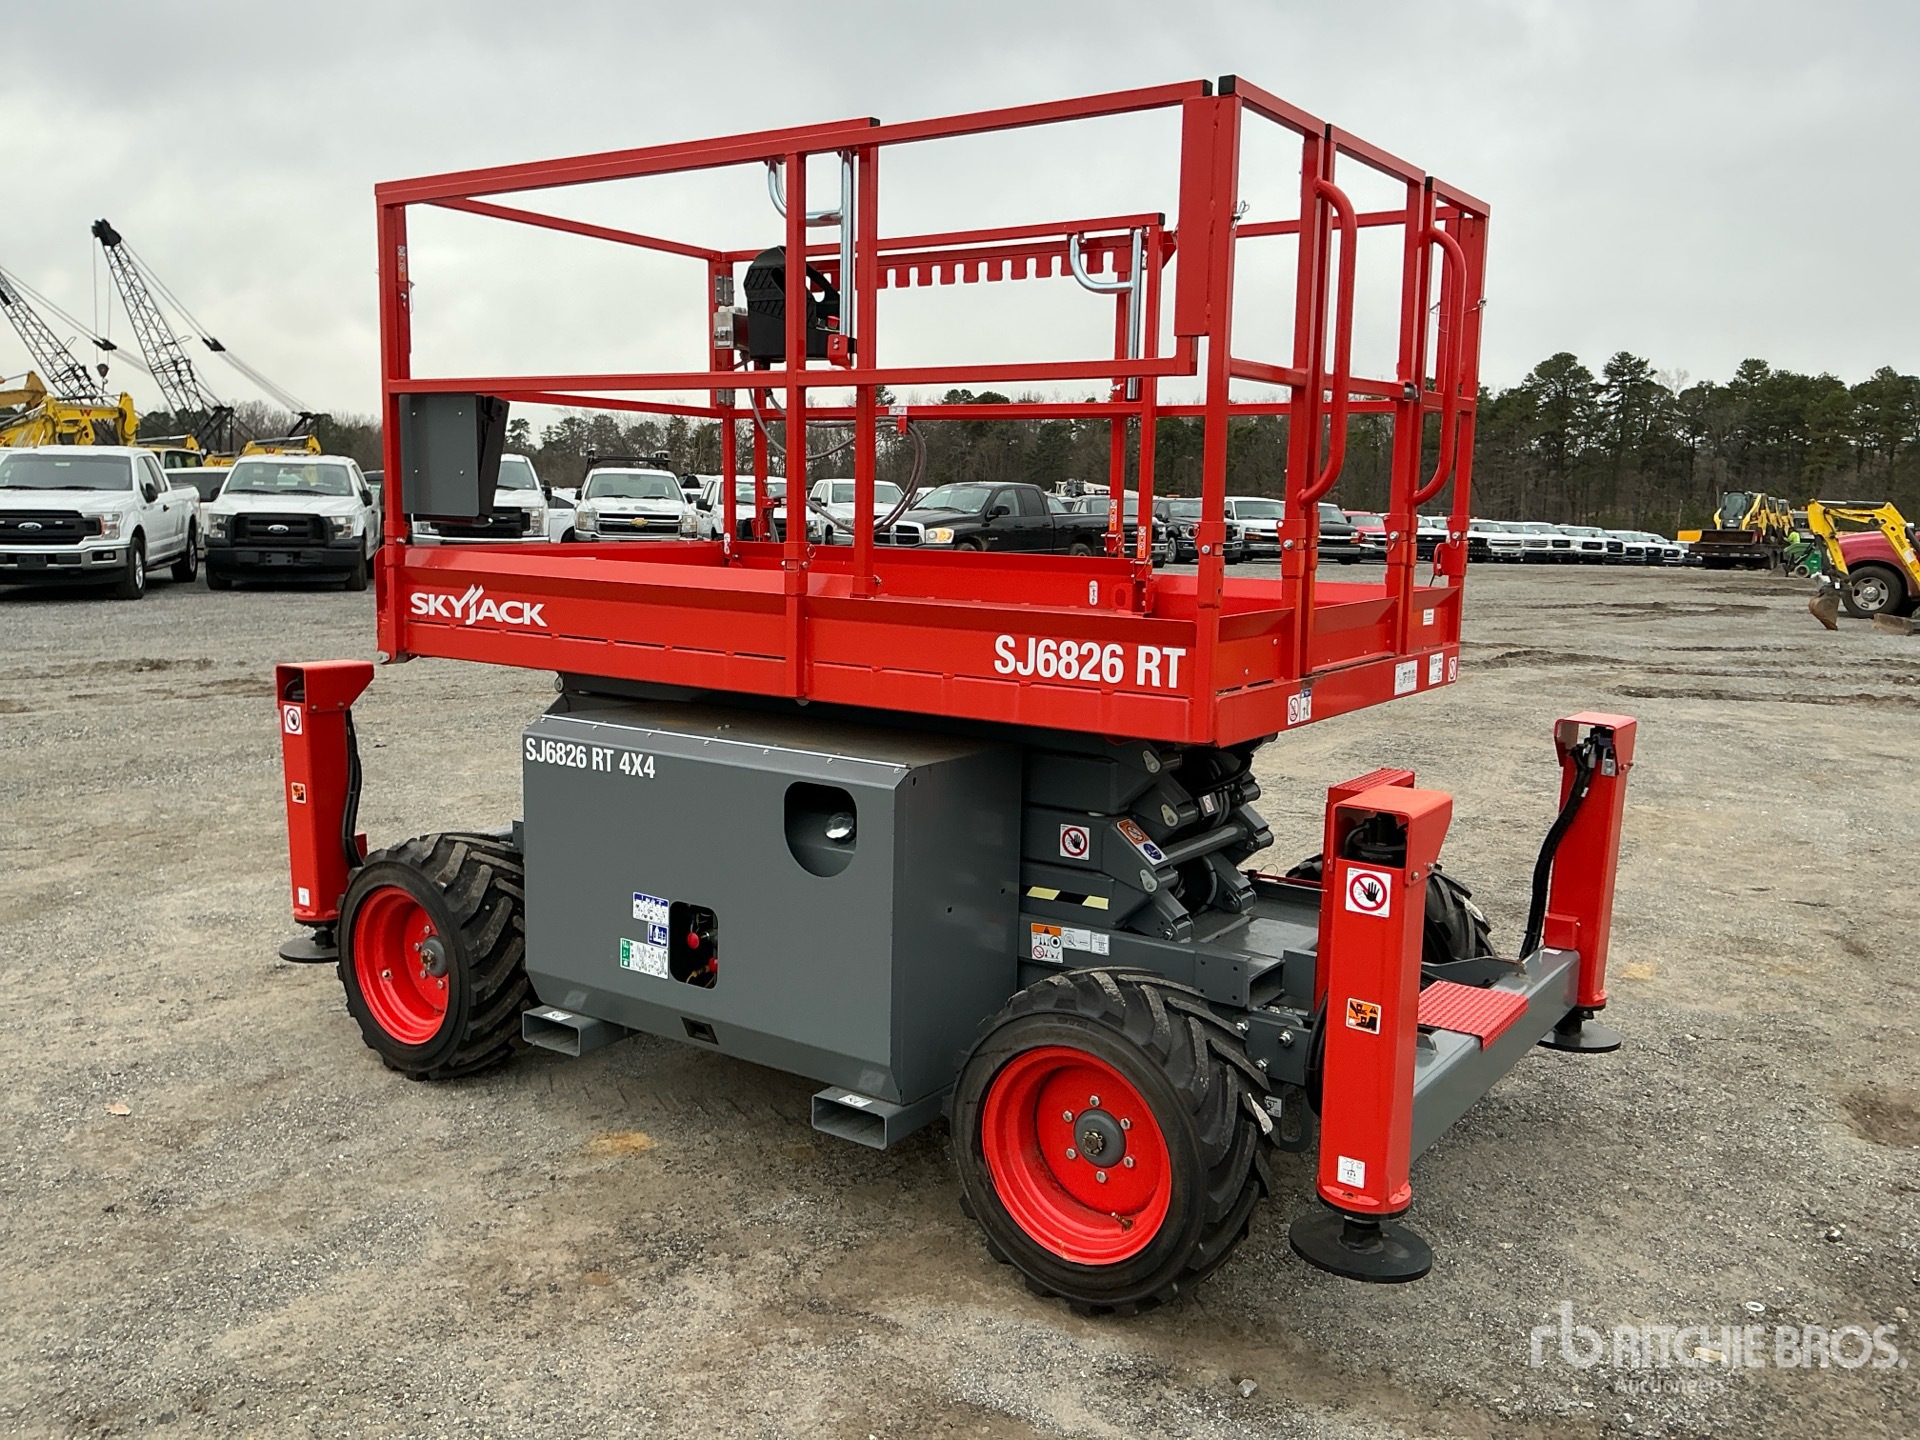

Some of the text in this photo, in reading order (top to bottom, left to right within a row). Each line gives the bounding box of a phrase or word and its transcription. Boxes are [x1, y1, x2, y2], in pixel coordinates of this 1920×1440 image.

[410, 584, 548, 627] SKYJACK
[994, 634, 1187, 689] SJ6826 RT
[525, 737, 656, 779] SJ6826 RT 4X4
